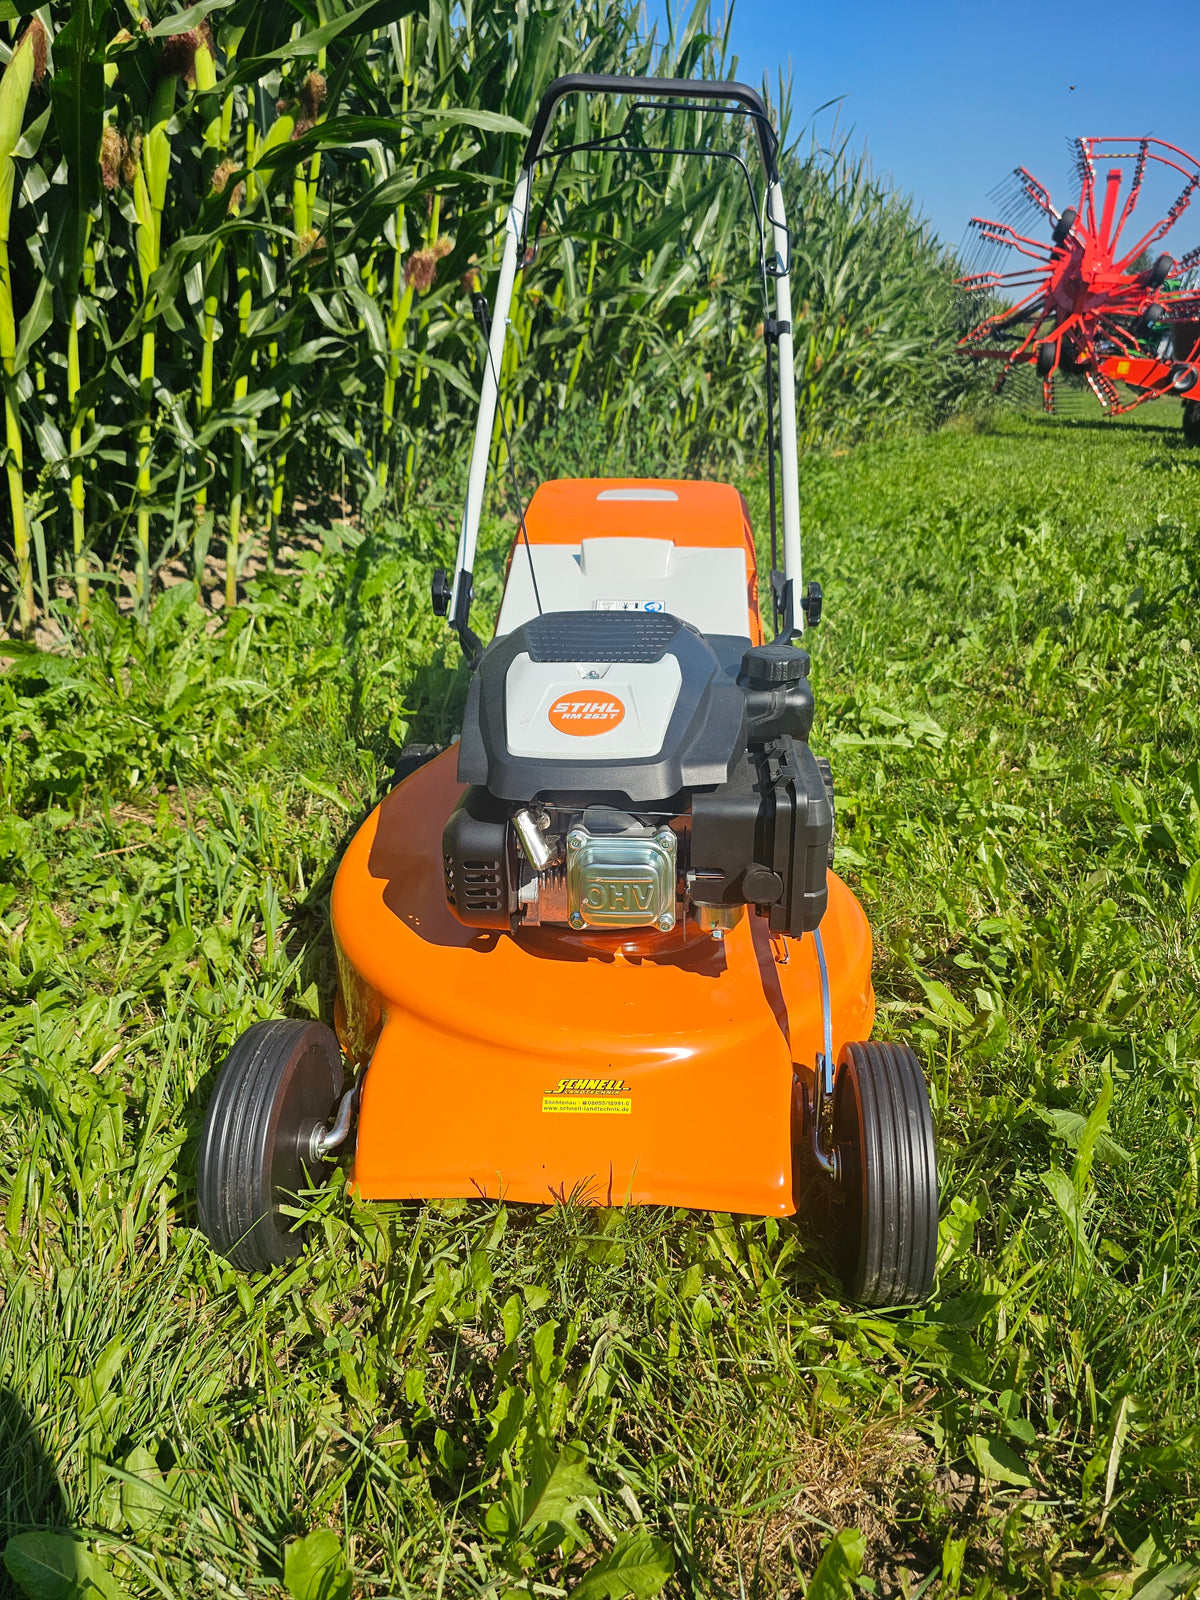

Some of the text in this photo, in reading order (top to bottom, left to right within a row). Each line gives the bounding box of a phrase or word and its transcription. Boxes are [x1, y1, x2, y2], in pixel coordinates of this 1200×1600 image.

[553, 702, 620, 713] STIHL
[586, 883, 655, 910] OHV
[550, 1079, 627, 1094] SCHNELL
